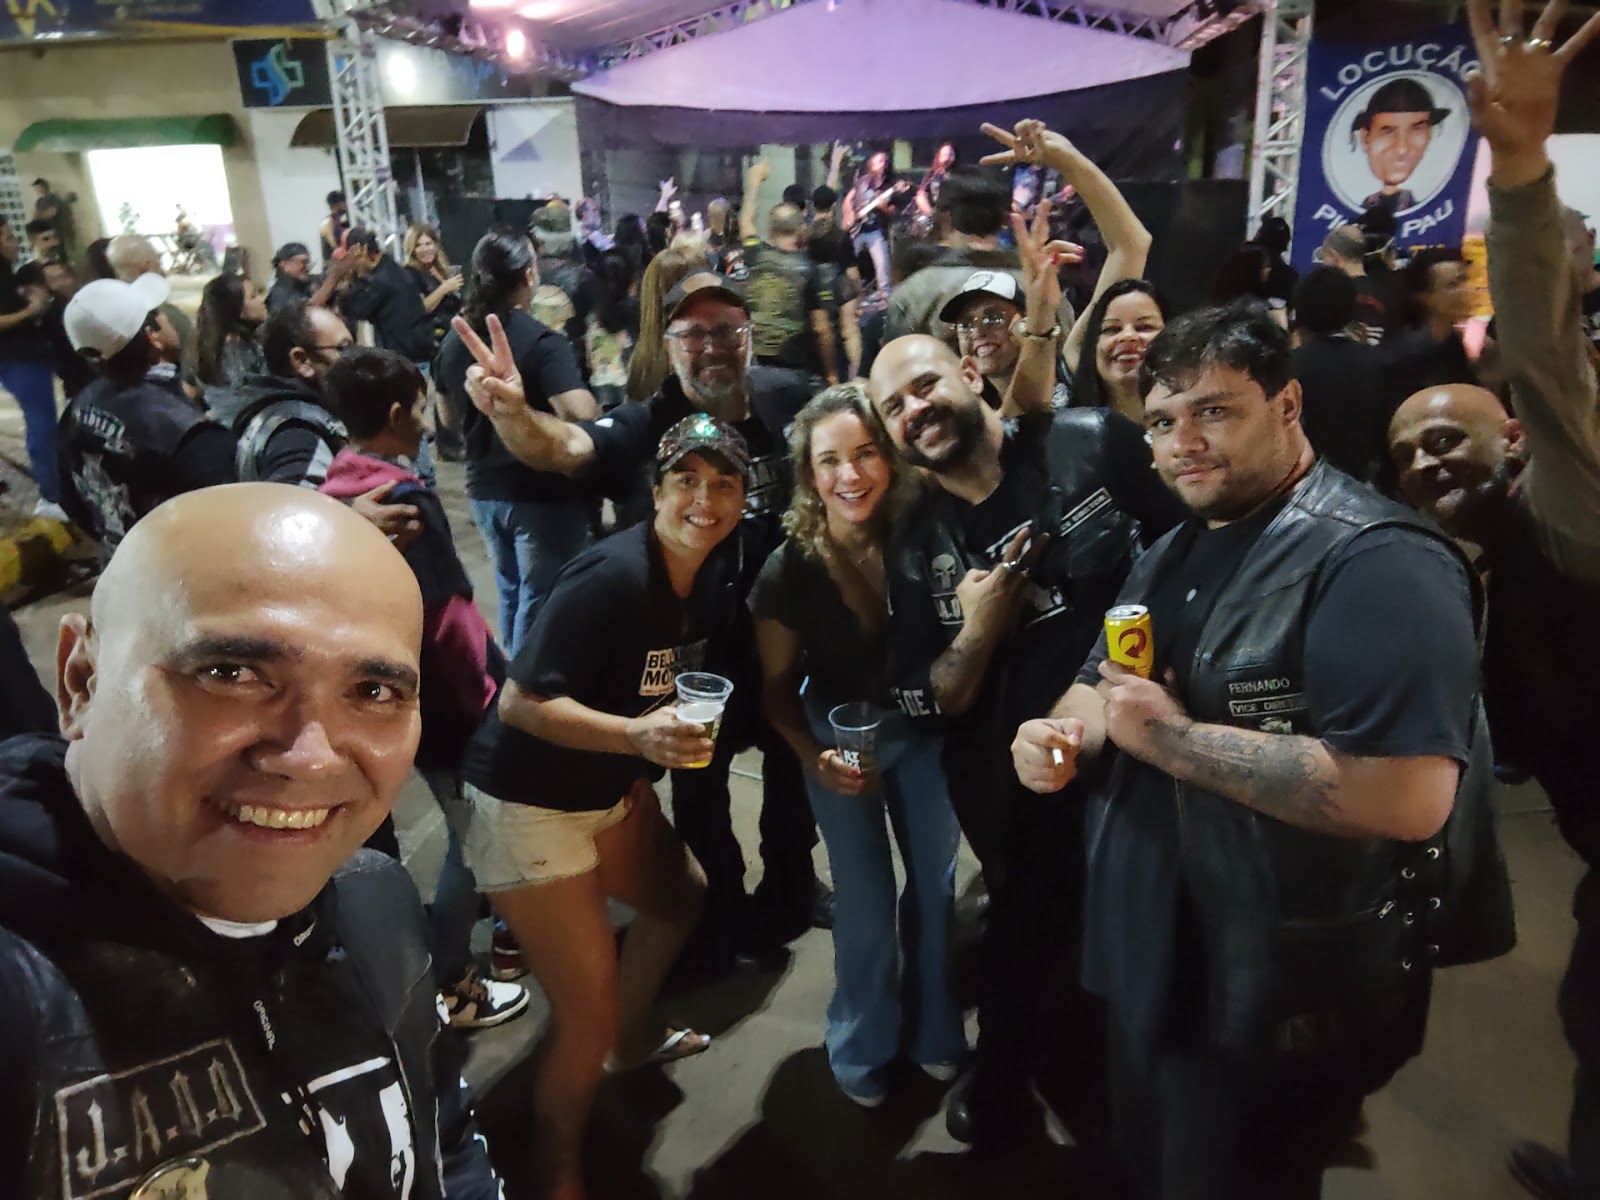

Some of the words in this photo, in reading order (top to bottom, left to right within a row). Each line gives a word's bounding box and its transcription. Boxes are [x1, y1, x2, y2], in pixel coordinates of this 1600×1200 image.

[1400, 199, 1454, 239] PAU
[1228, 677, 1290, 695] FERNANDO
[1233, 702, 1259, 714] VICE
